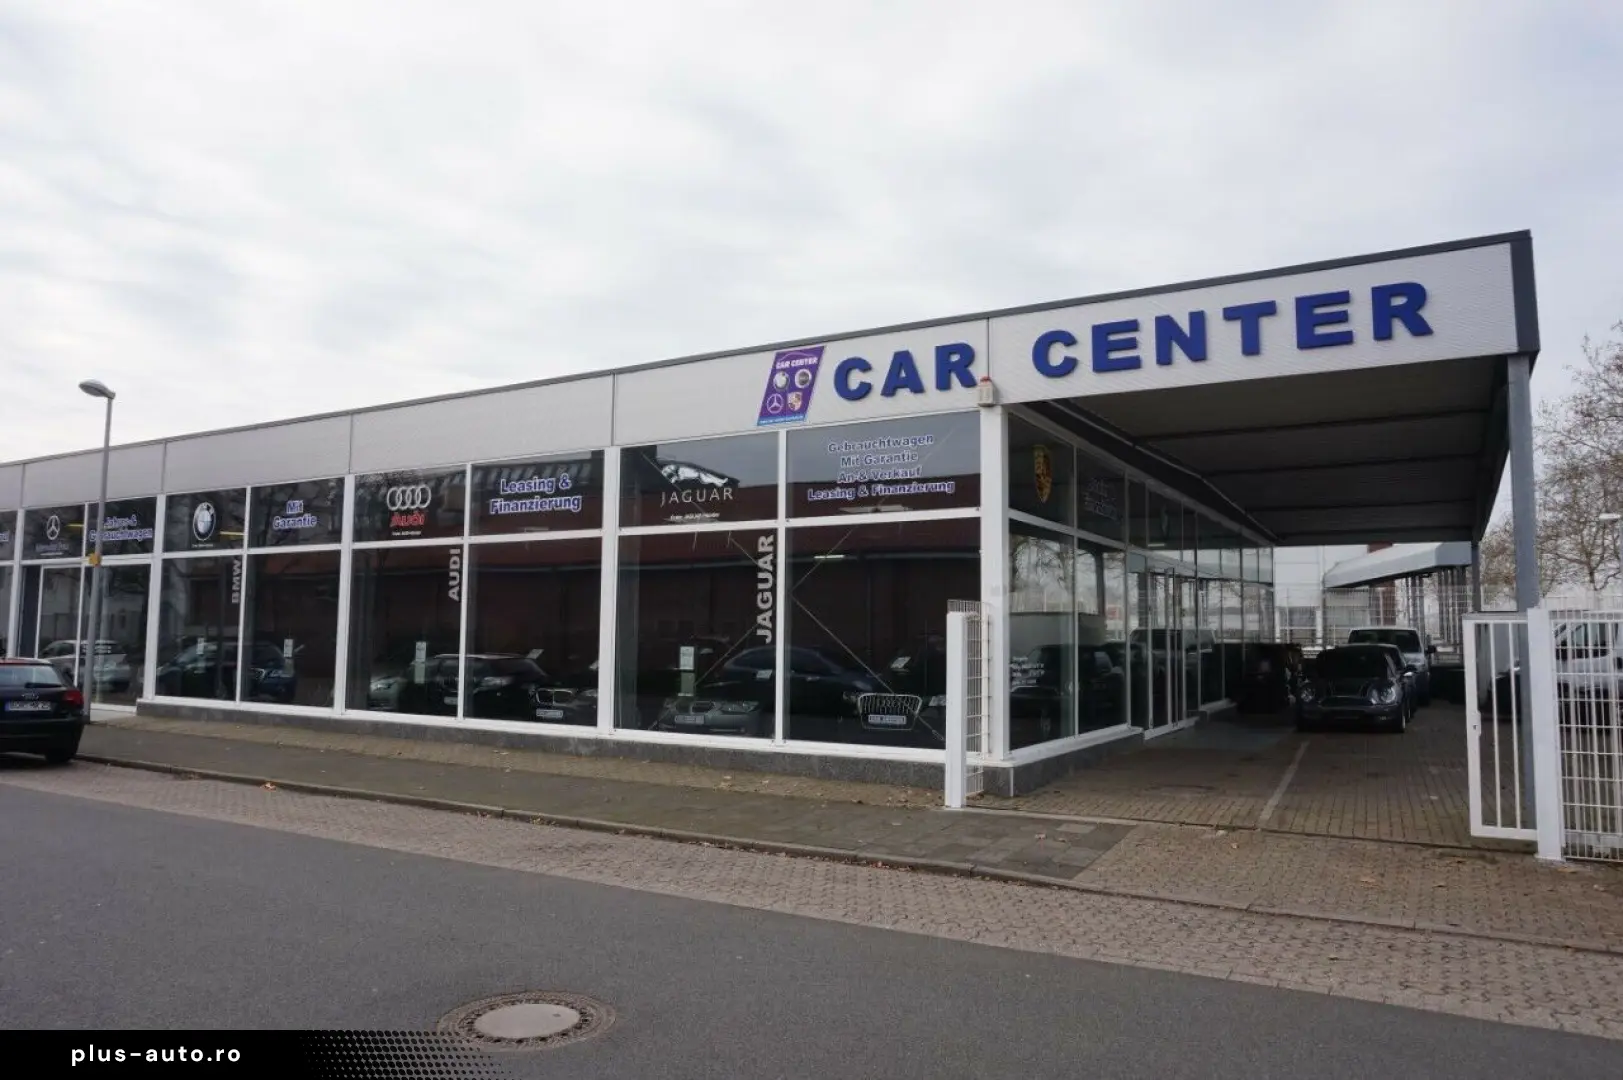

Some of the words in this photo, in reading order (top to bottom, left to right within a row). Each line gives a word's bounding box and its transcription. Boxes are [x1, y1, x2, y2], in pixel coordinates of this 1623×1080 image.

[833, 343, 977, 402] CAR
[1032, 281, 1434, 378] CENTER
[776, 361, 790, 370] CAR
[791, 356, 818, 368] CENTER
[828, 434, 934, 453] Gebrauchtwagen
[840, 456, 861, 468] Mit
[863, 449, 919, 466] Garantie
[871, 465, 923, 480] Verkauf
[500, 475, 556, 495] Leasing
[558, 472, 573, 490] &
[807, 486, 856, 501] Leasing
[857, 484, 869, 497] &
[870, 480, 956, 497] Finanzierung
[286, 500, 304, 515] Mit
[489, 495, 583, 515] Finanzierung
[660, 487, 734, 508] JAGUAR
[273, 512, 318, 531] Garantie
[231, 558, 242, 604] BMW
[447, 548, 461, 602] AUDI
[756, 534, 775, 645] JAGUAR
